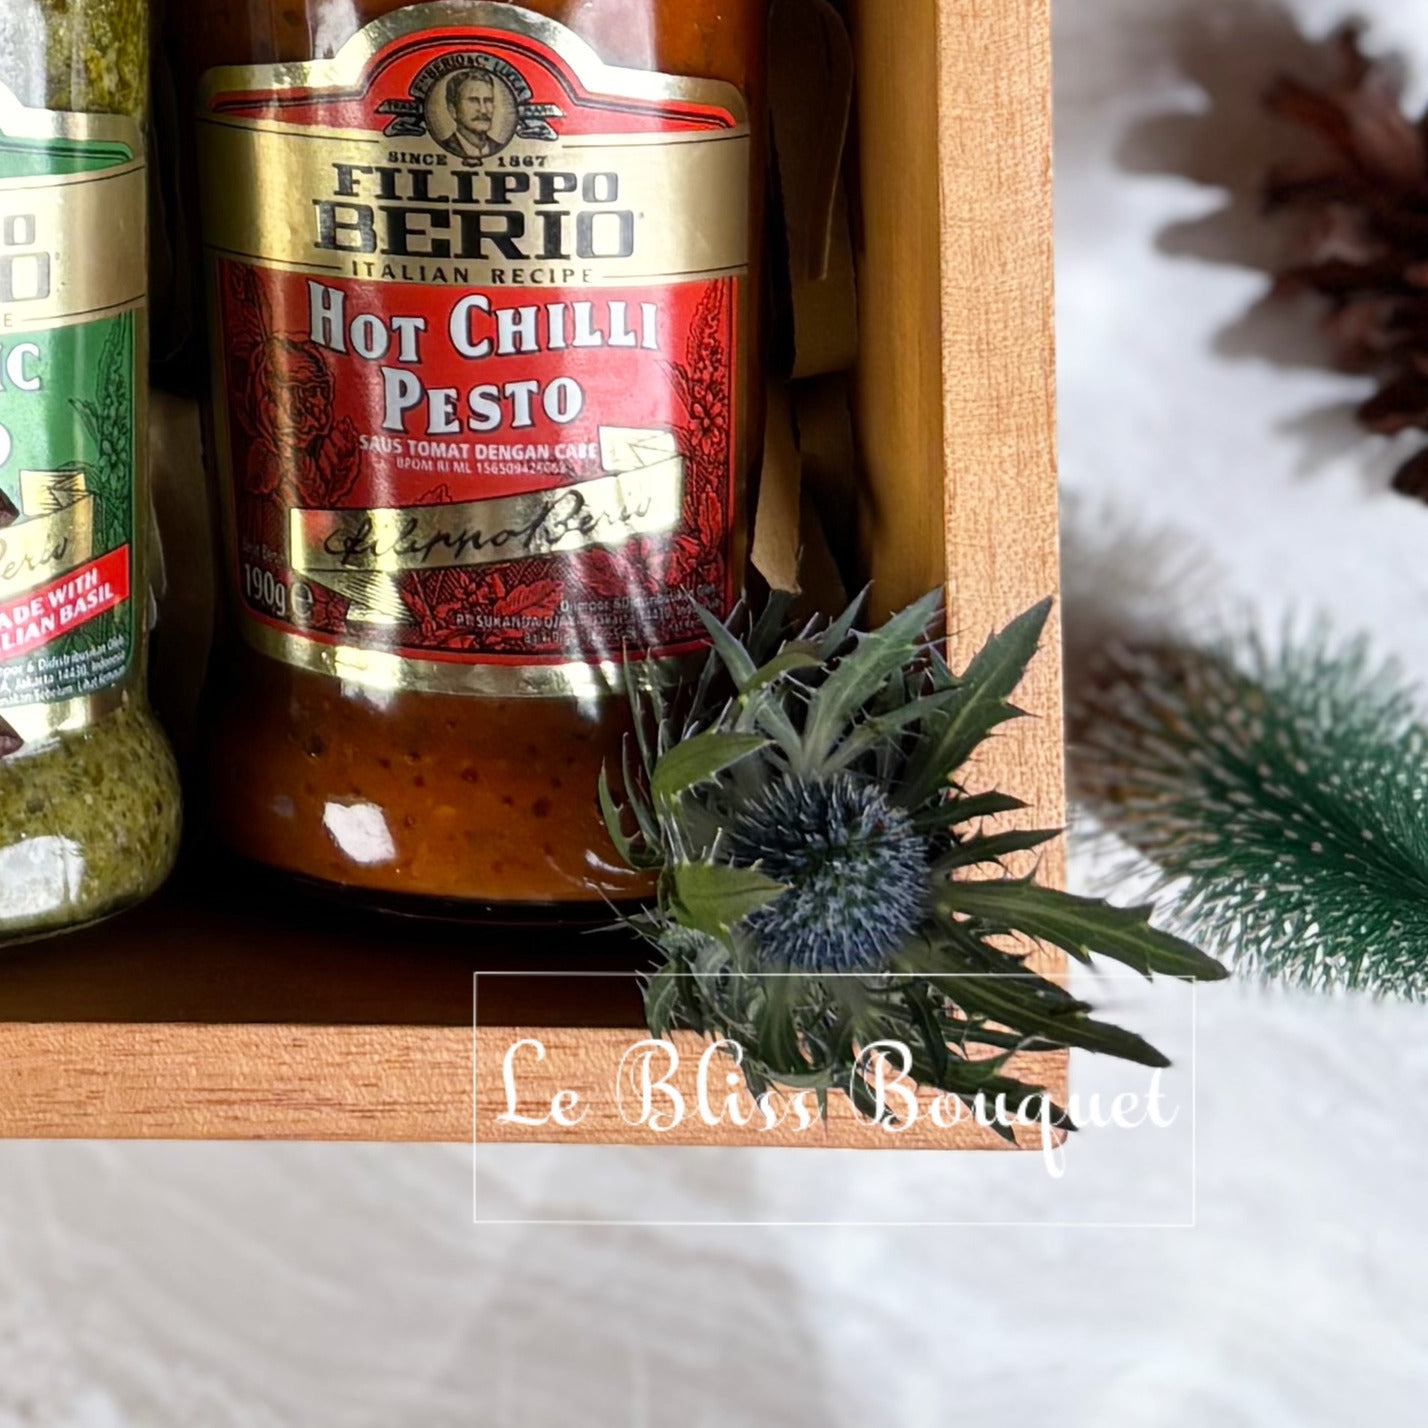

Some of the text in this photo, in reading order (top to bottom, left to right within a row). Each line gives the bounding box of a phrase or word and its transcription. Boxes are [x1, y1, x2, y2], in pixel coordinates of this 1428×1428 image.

[331, 162, 619, 204] FILIPPO
[311, 198, 635, 260] BERIO
[352, 260, 593, 285] ITALIAN RECIPE
[407, 439, 550, 460] TOMAT DENGAN
[47, 568, 99, 608] WITH
[60, 583, 114, 624] BASIL
[243, 562, 286, 615] 190g
